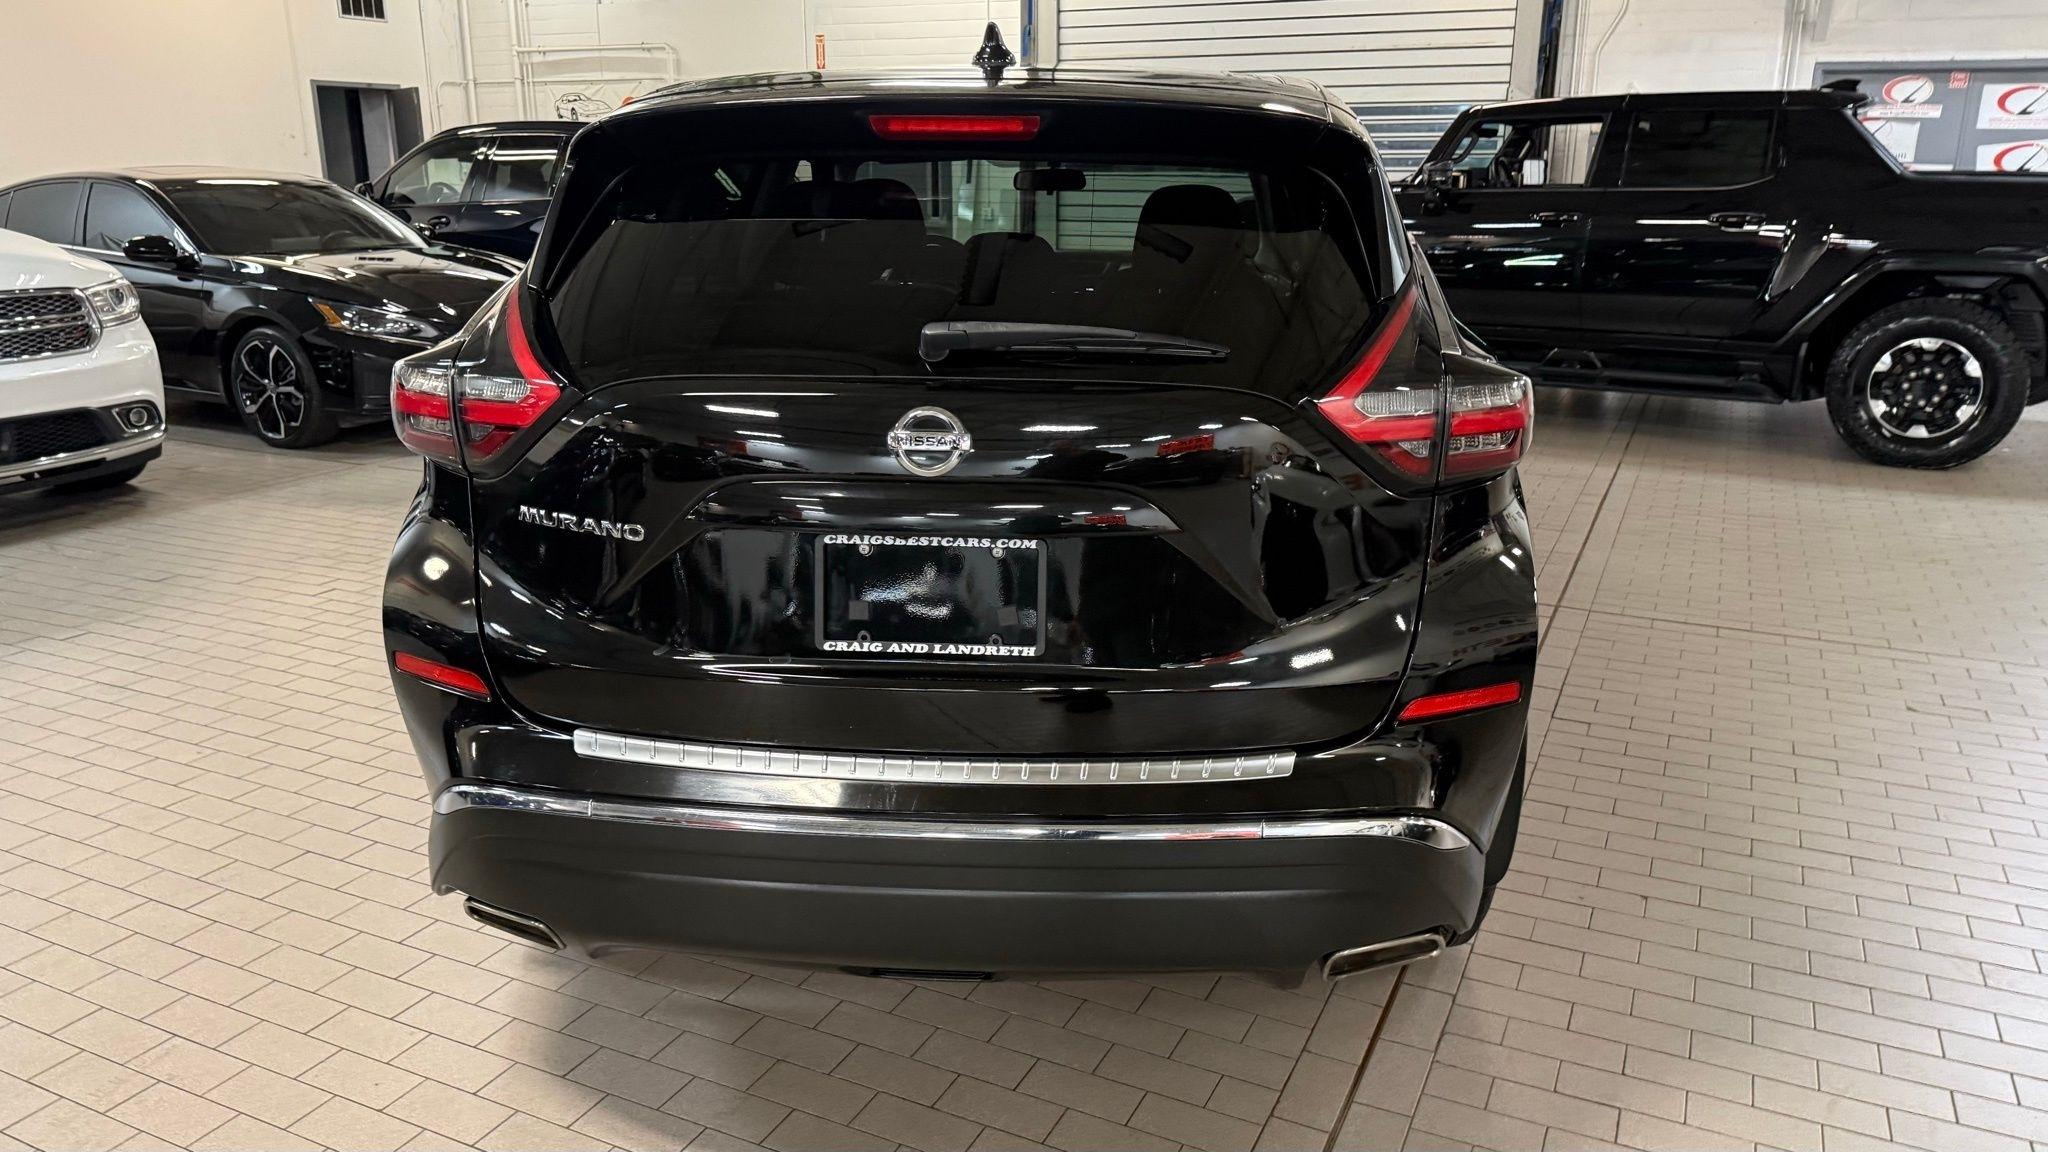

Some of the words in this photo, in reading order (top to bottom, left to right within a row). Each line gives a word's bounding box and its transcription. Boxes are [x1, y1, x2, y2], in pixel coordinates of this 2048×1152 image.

[896, 435, 961, 447] NISSAN
[518, 504, 645, 542] MURANO
[823, 641, 883, 653] CRAIG
[887, 642, 929, 654] AND
[933, 643, 1036, 656] LANDRETH
